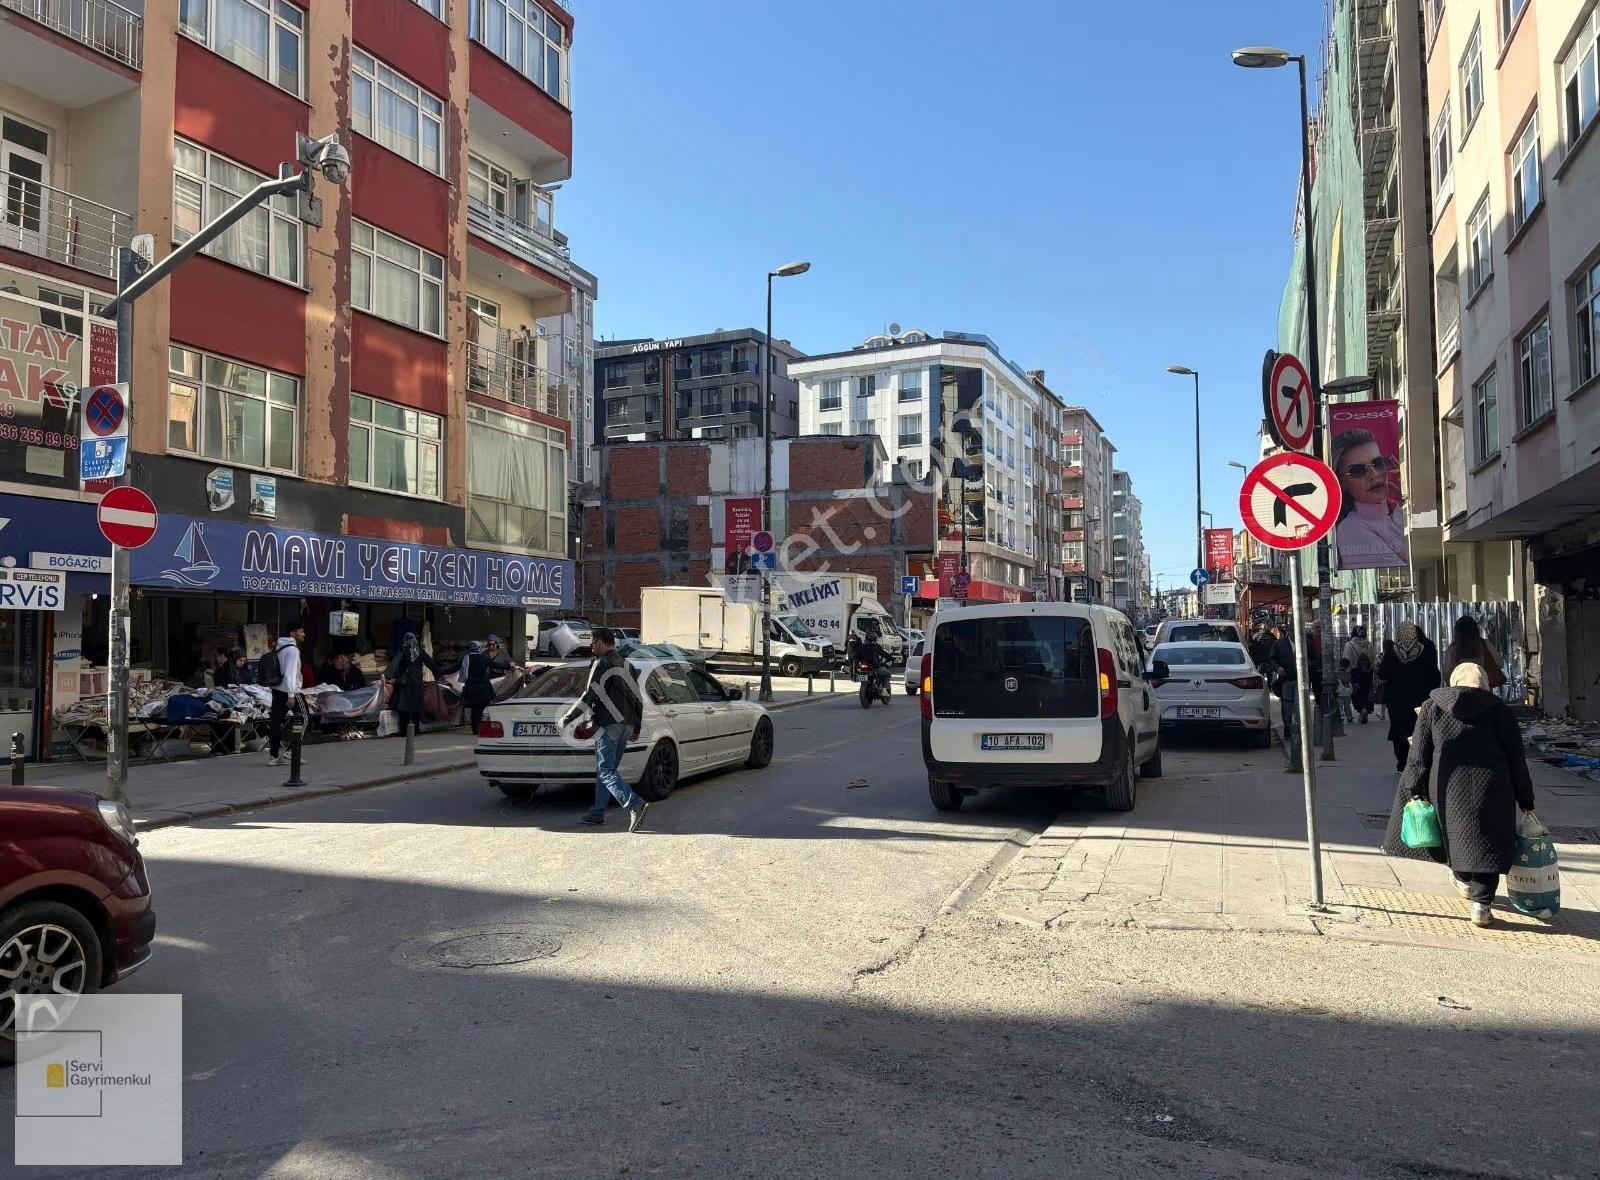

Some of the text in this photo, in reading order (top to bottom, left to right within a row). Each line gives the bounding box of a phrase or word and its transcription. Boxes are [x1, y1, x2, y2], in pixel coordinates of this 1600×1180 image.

[0, 317, 79, 363] TAY
[664, 339, 683, 348] YAPI
[20, 427, 43, 444] 265
[46, 432, 60, 447] 89
[64, 435, 78, 450] 89
[50, 556, 102, 571] BOĞAZİÇİ
[358, 543, 477, 589] YELKEN
[486, 557, 562, 594] HOME
[29, 574, 57, 582] TELEFONU
[242, 576, 290, 592] TOPTAN
[300, 581, 360, 596] PERAKENDE
[818, 620, 829, 629] 43
[829, 620, 840, 629] 44
[518, 725, 528, 734] 34
[531, 725, 541, 735] TV
[989, 735, 1043, 746] 10 AFA 102
